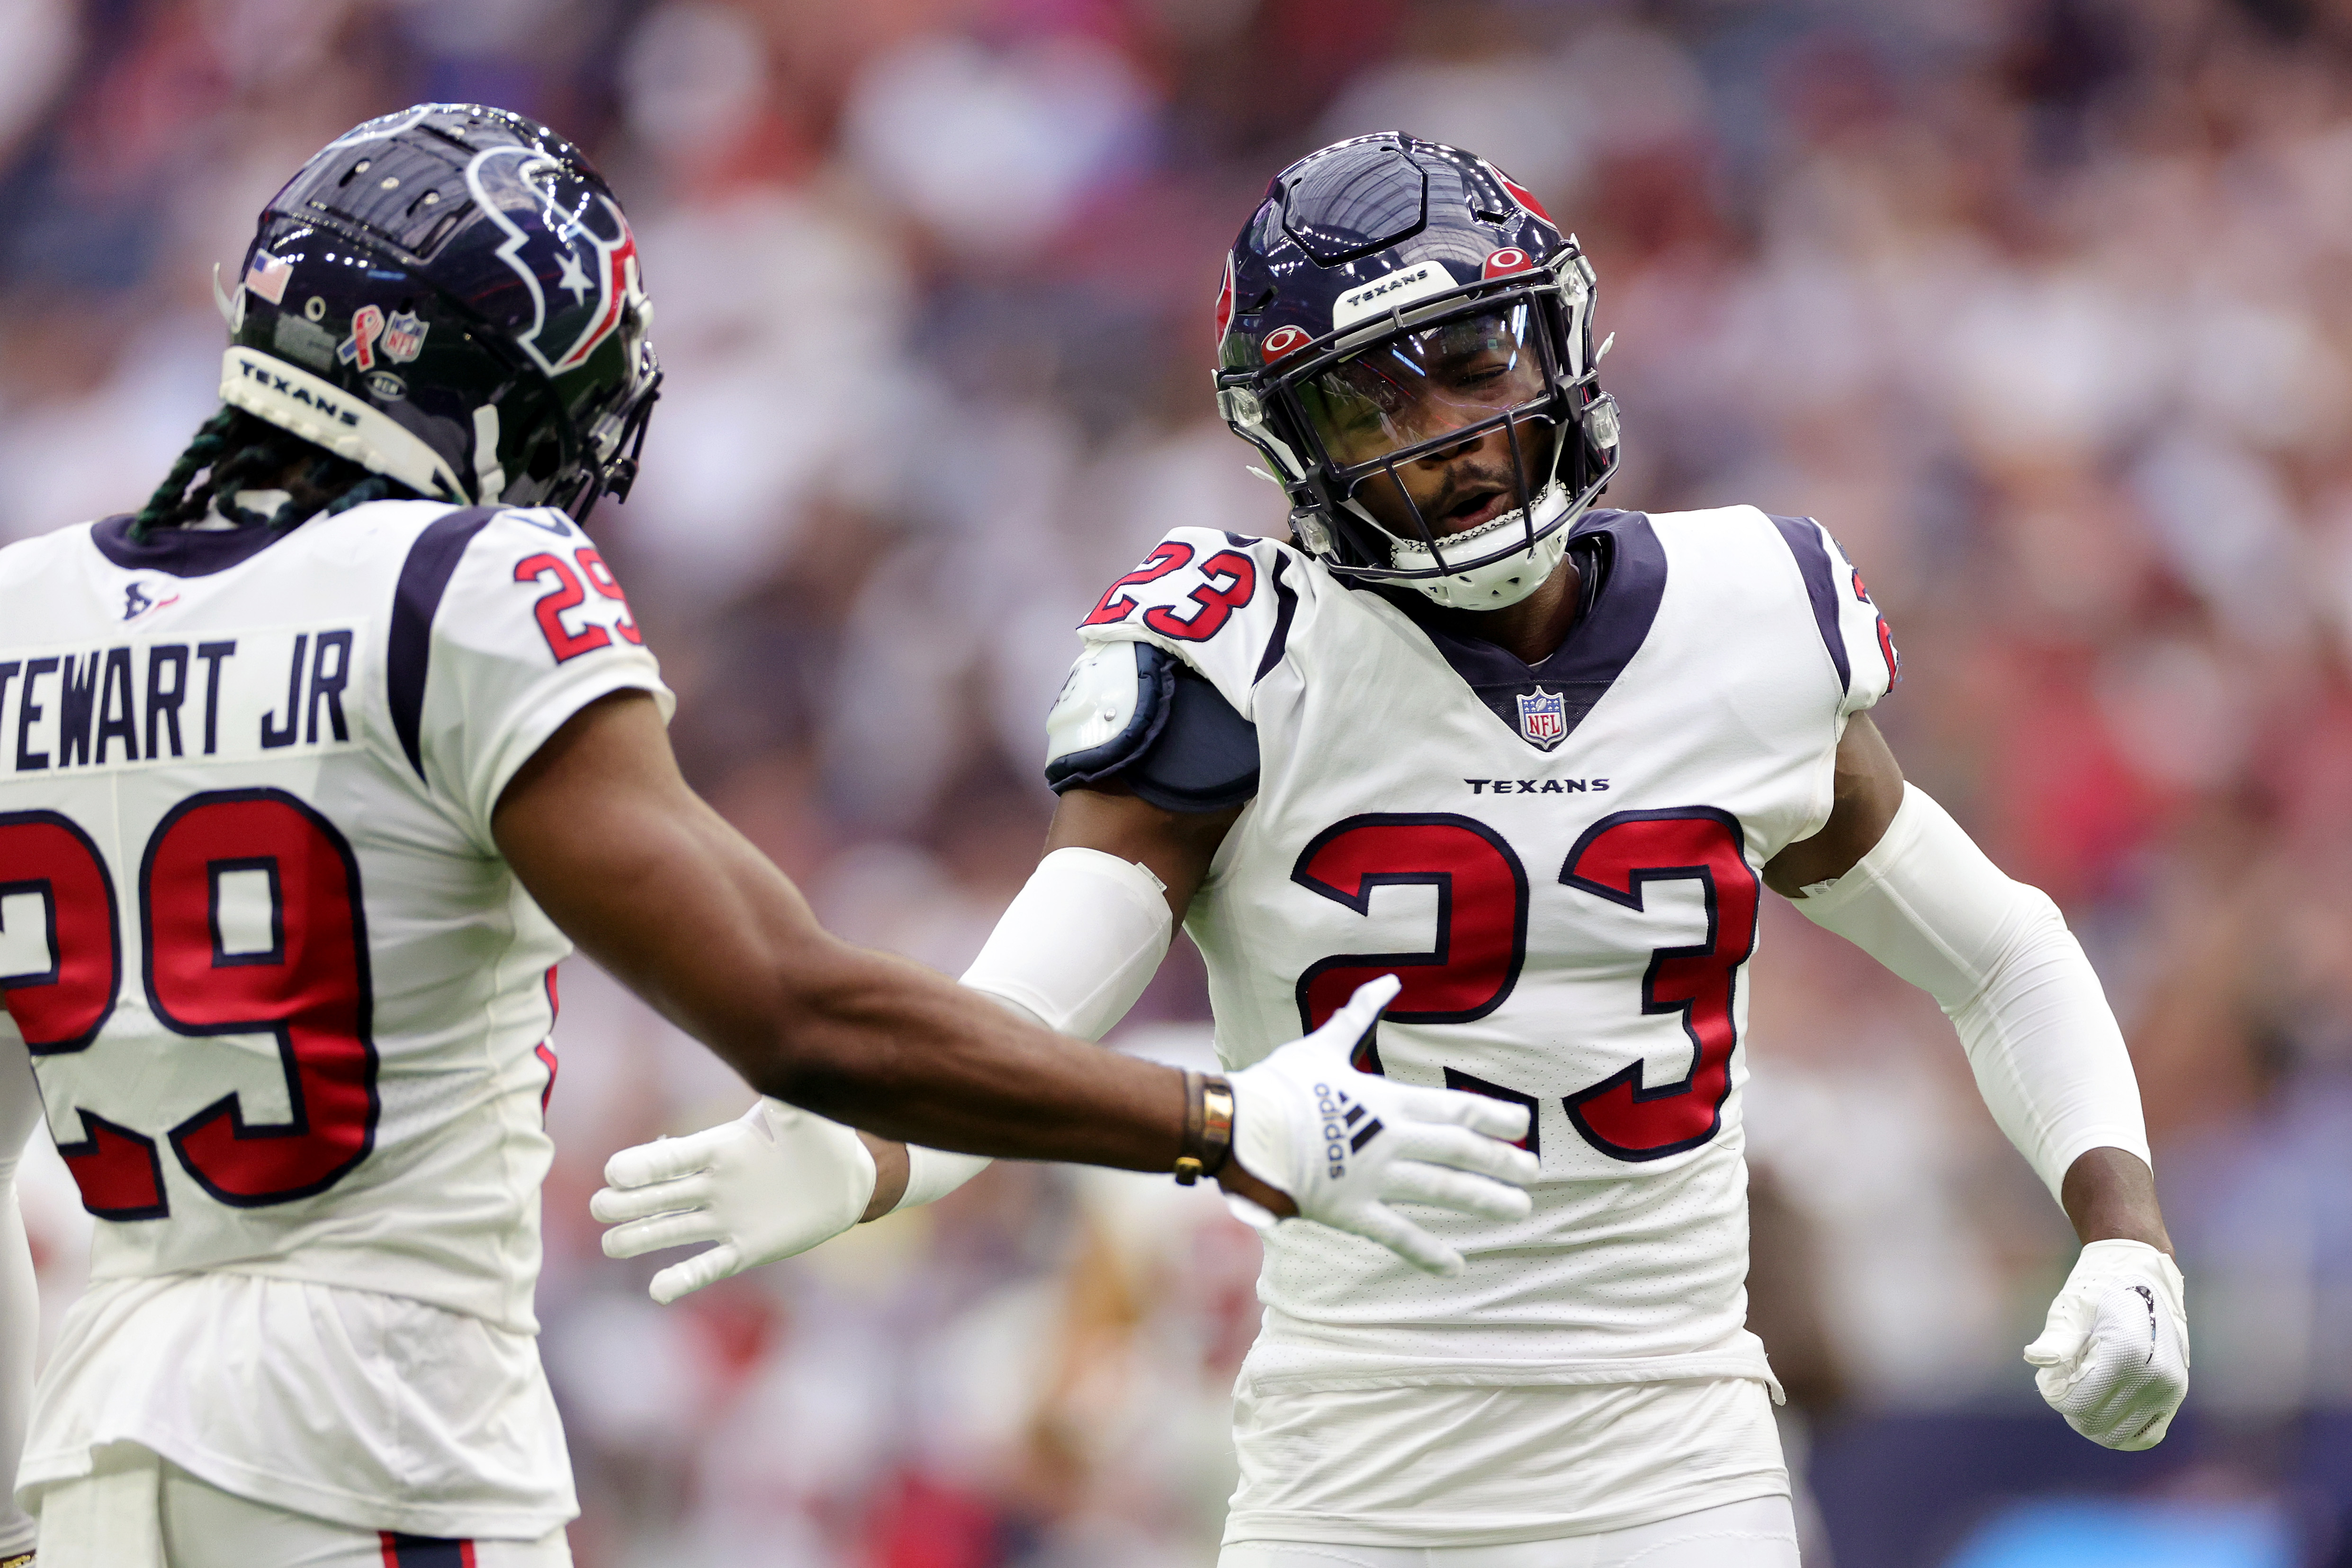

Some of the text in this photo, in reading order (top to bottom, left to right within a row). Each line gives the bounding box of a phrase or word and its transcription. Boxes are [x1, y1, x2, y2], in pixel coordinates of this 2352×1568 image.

[1347, 269, 1428, 306] TEXANS
[239, 358, 360, 426] TEXANS
[1076, 540, 1256, 643] 23
[260, 629, 354, 749] JR
[1528, 713, 1561, 737] NFL
[1463, 778, 1610, 794] TEXANS
[1290, 805, 1760, 1163] 23
[1313, 1082, 1346, 1180] adidas
